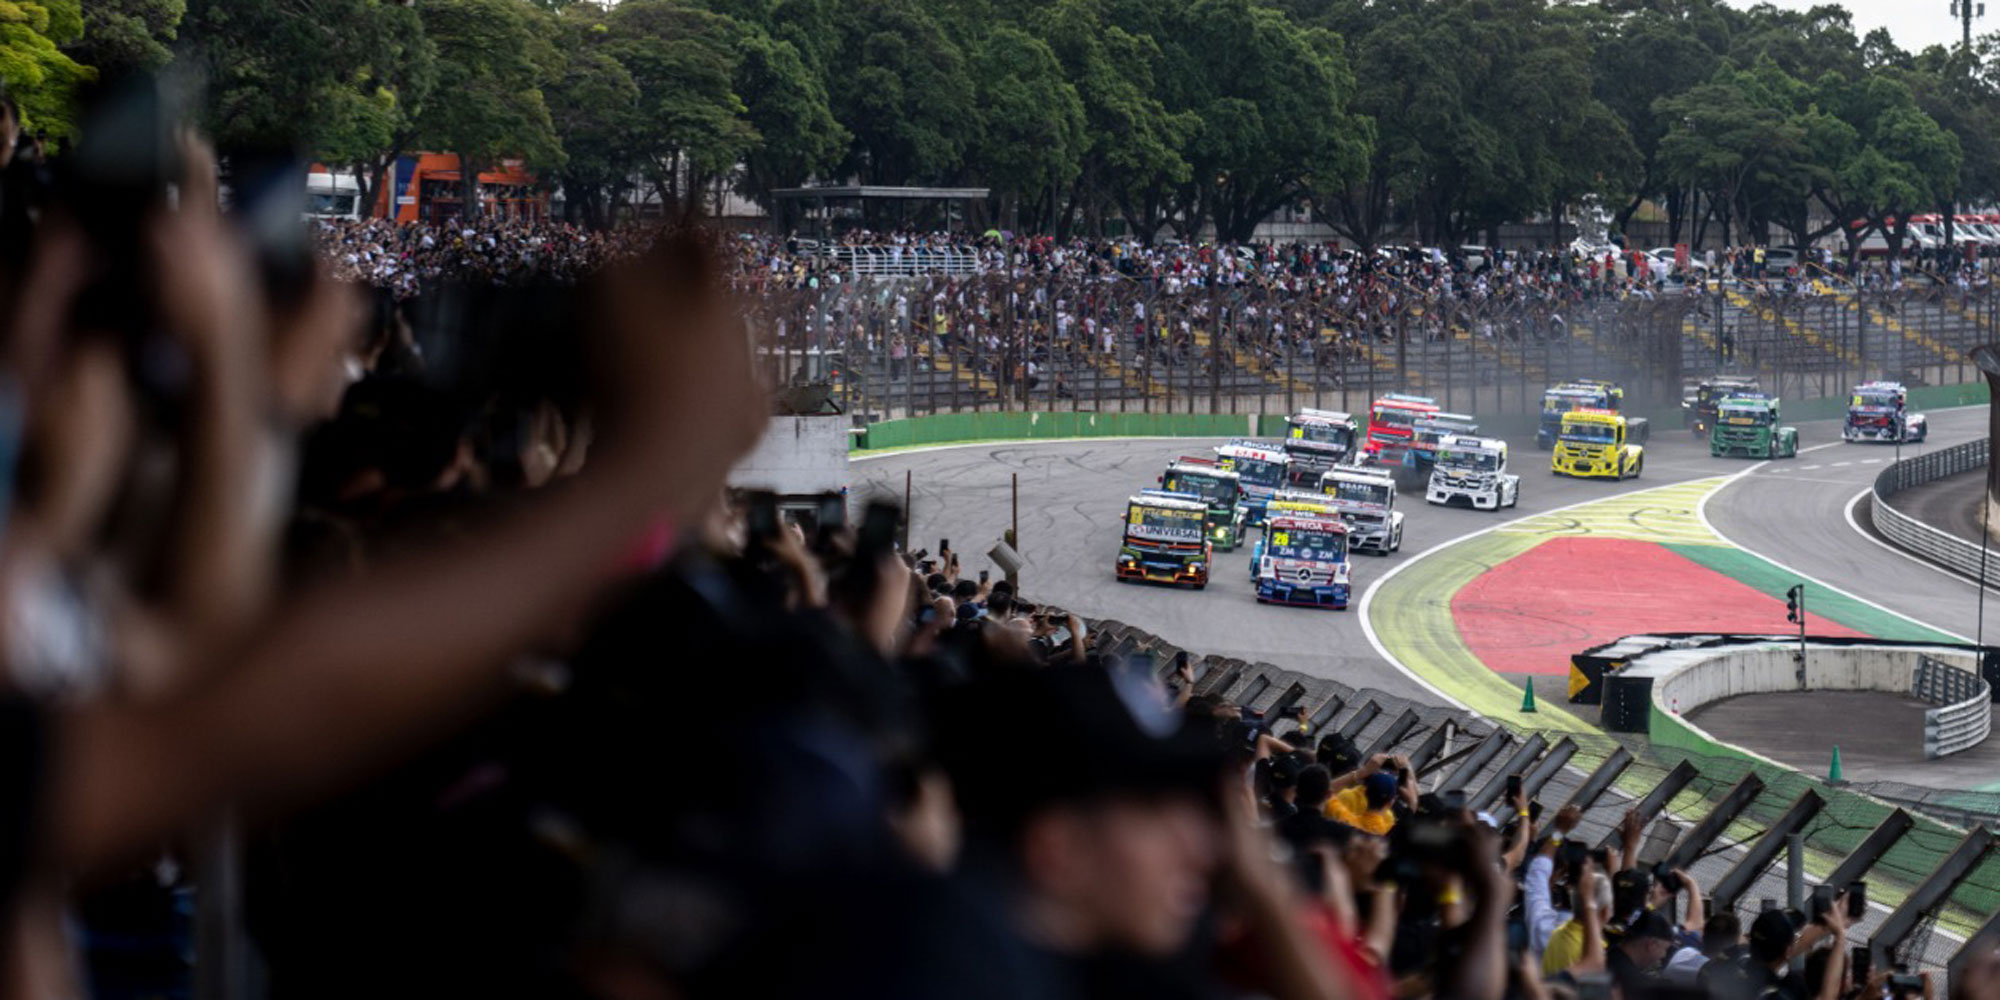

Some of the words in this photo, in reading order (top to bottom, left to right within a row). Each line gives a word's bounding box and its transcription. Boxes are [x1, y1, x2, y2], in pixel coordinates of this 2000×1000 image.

[1145, 526, 1200, 538] UNIVERSAL
[1280, 547, 1295, 556] ZM
[1318, 551, 1334, 560] ZM
